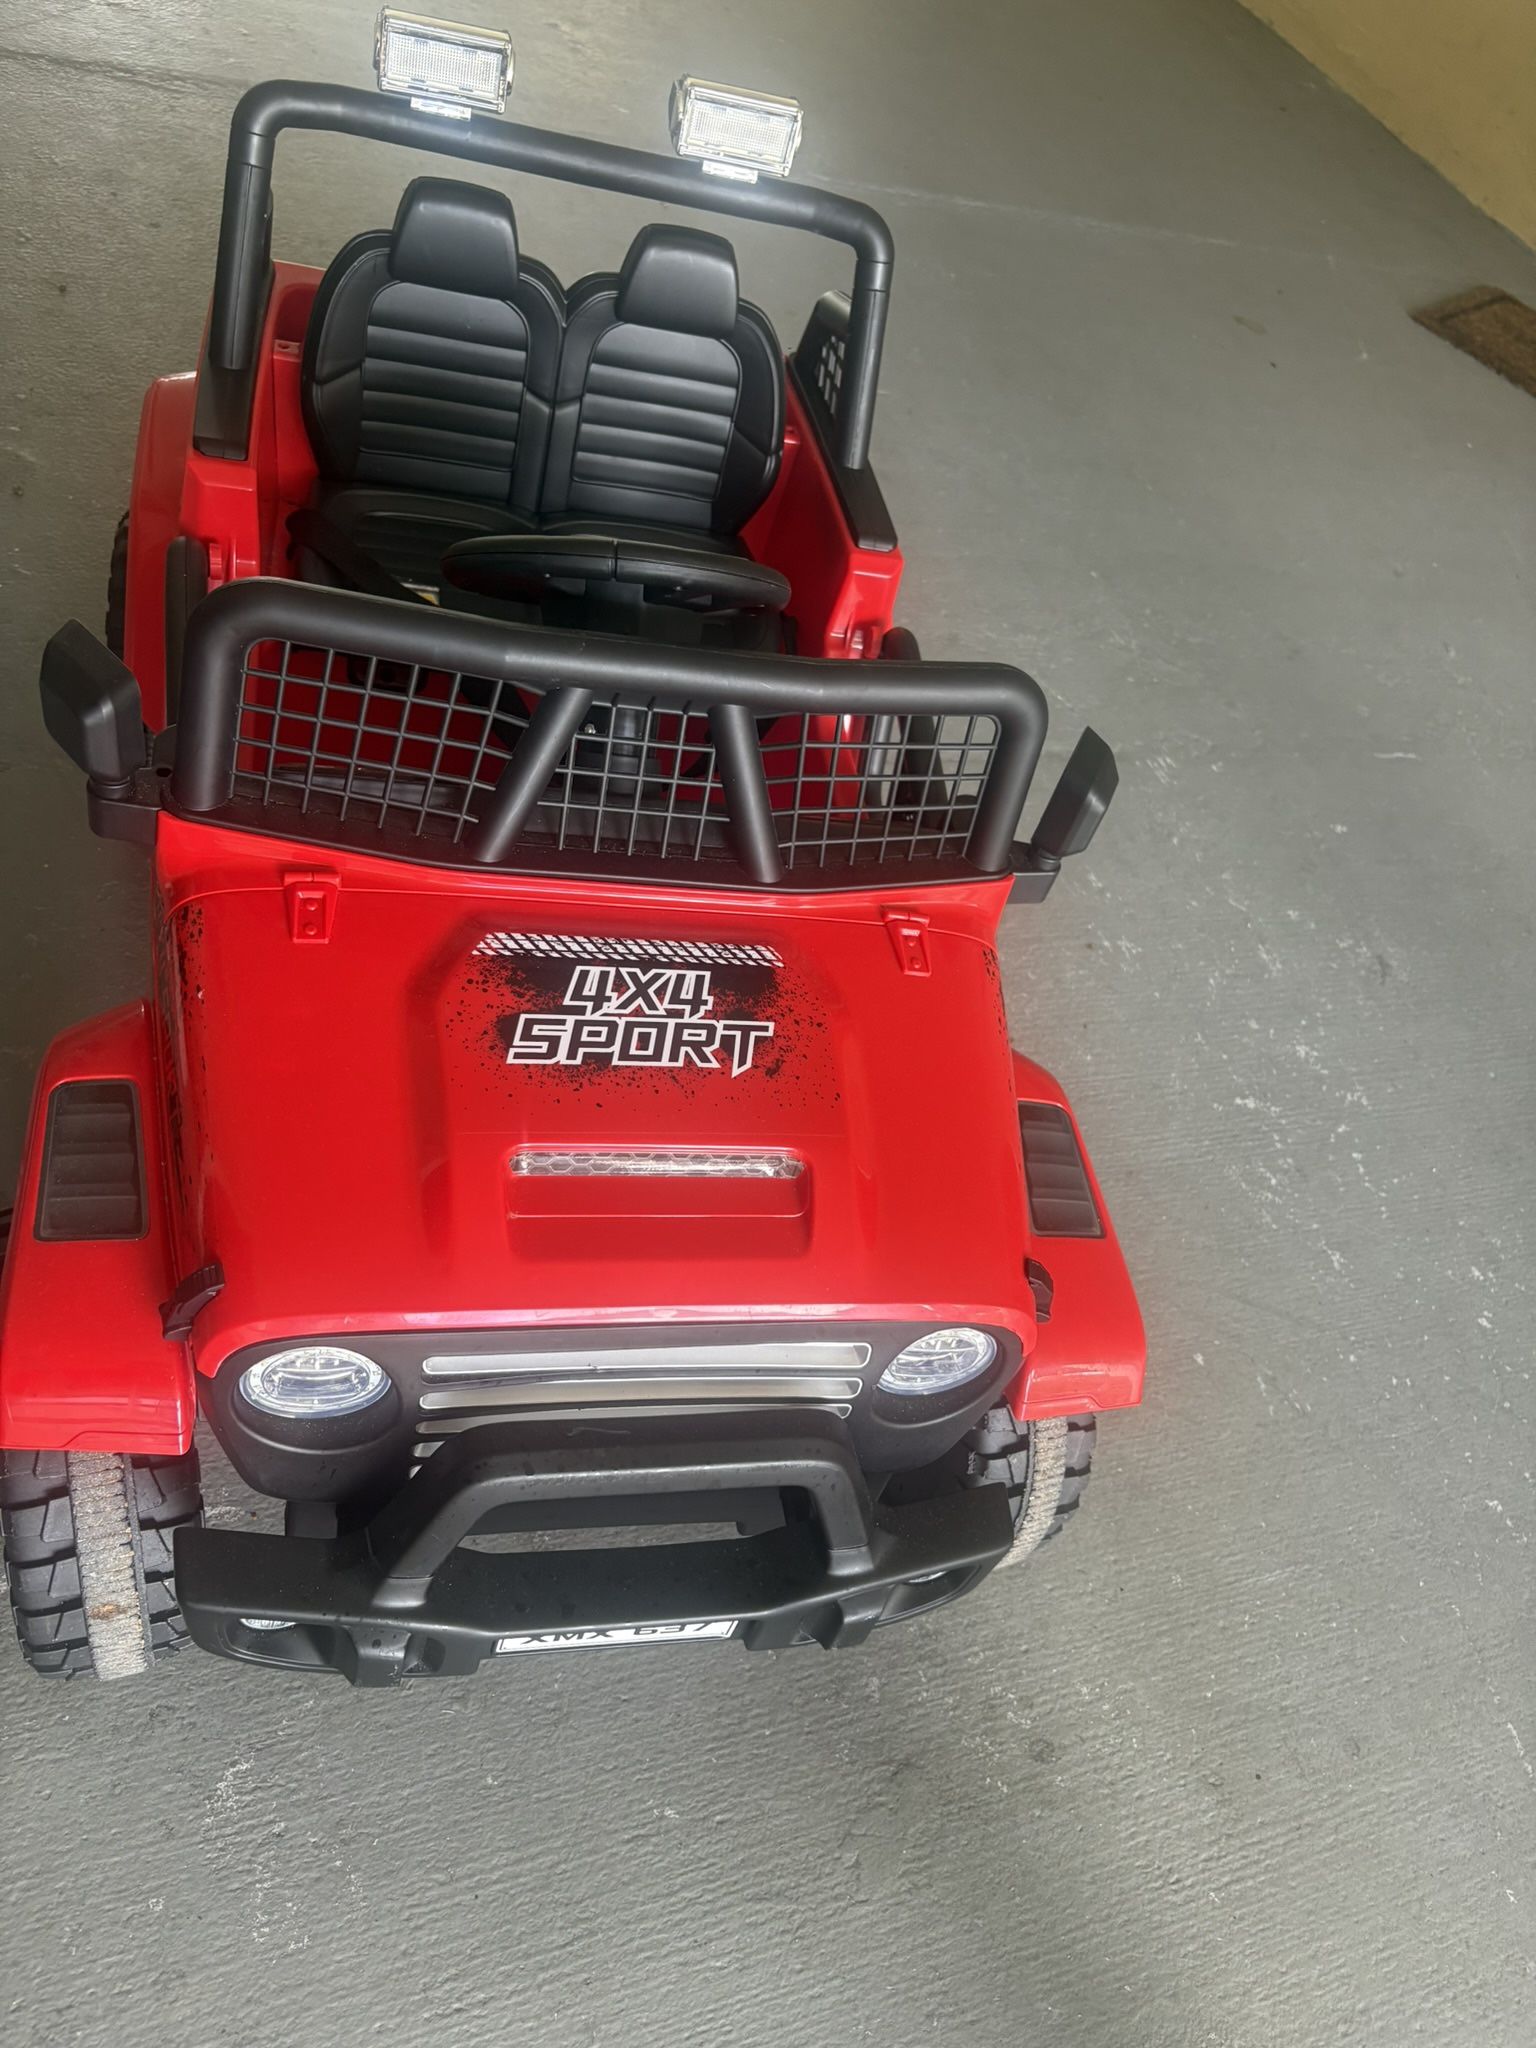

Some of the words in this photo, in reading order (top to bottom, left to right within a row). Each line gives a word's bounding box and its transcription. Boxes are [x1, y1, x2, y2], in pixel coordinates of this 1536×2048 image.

[563, 965, 713, 1019] 4X4
[506, 1013, 775, 1078] SPORT
[521, 1630, 614, 1645] XMX
